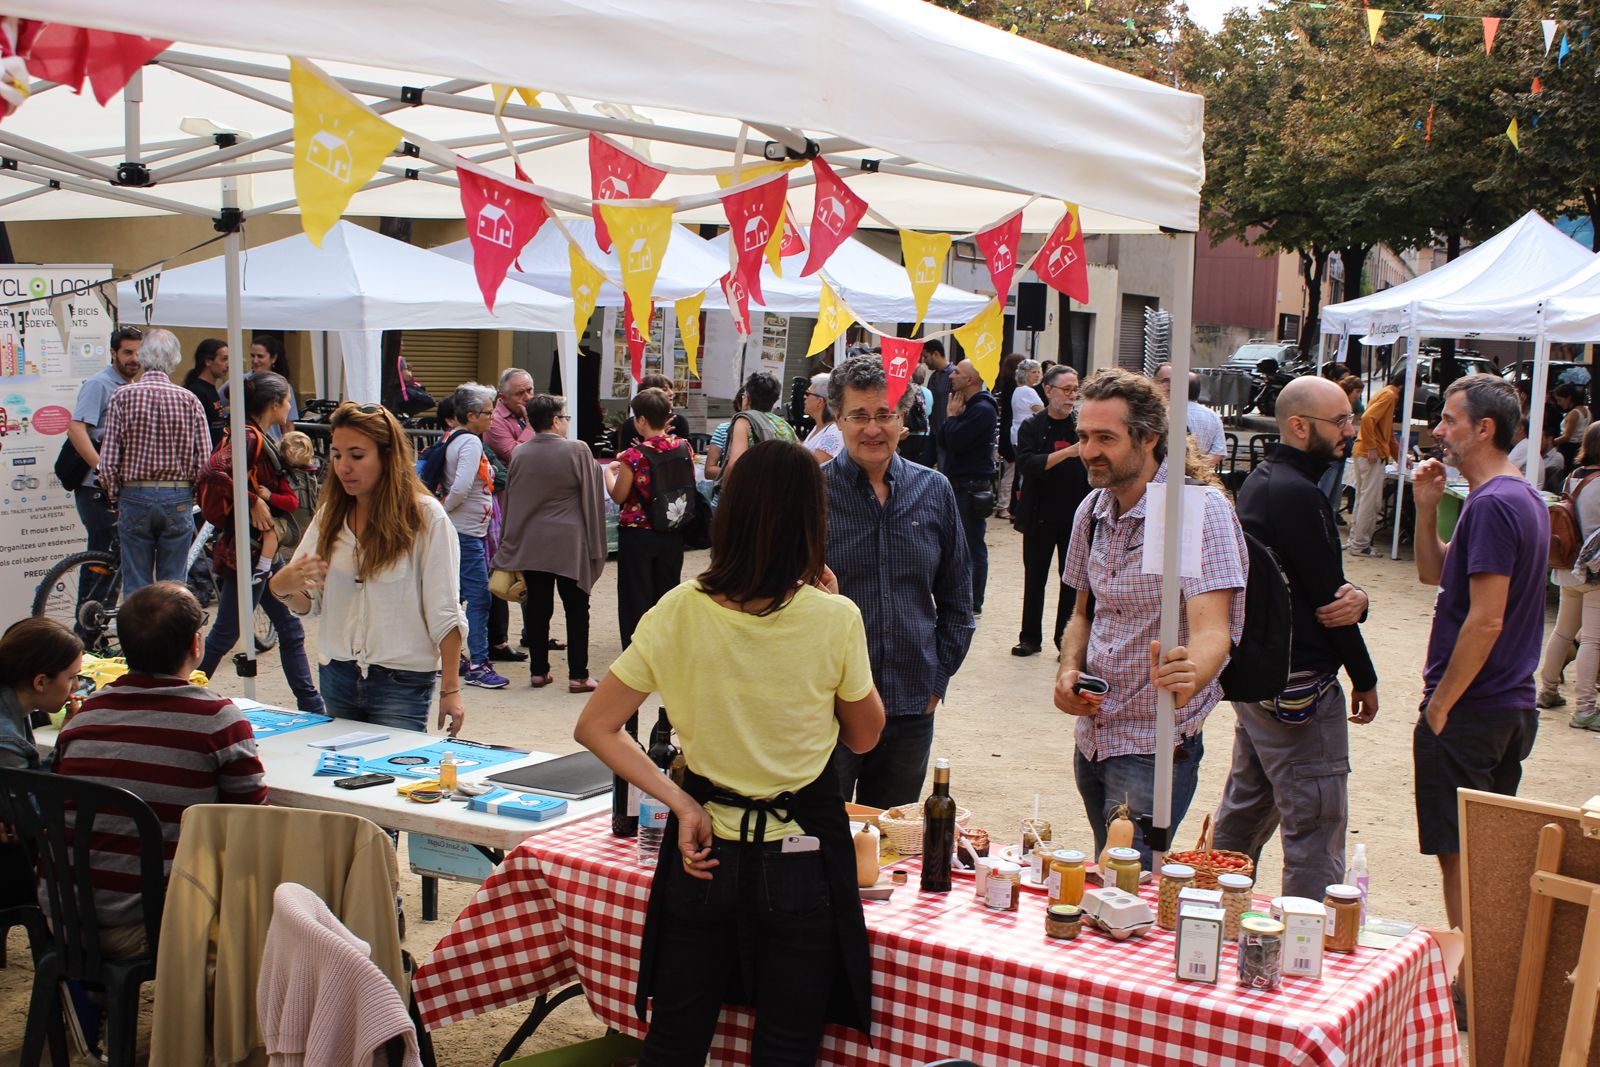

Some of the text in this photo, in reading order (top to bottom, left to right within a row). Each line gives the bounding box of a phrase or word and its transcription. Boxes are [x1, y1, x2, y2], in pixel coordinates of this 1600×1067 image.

[78, 307, 99, 316] BICIS
[21, 528, 29, 536] Et
[30, 526, 49, 534] mous
[60, 523, 75, 531] bici?
[48, 537, 87, 547] esdevenime
